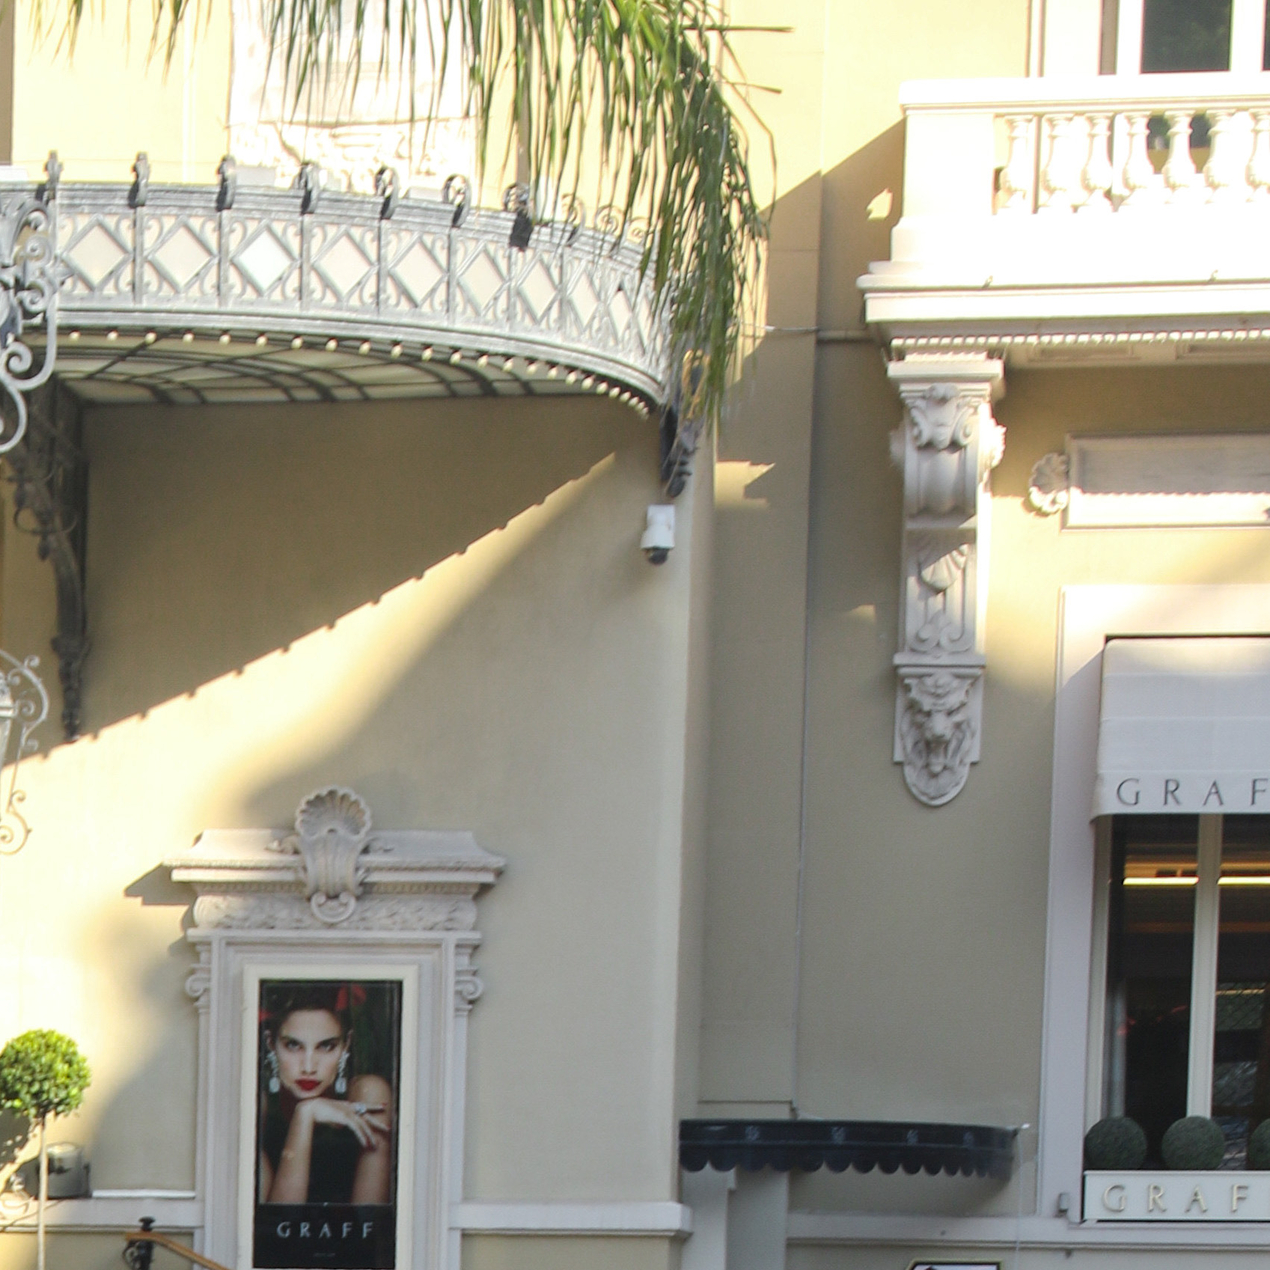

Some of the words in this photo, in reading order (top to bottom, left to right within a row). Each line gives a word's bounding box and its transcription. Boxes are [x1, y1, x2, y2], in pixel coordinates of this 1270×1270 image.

[1116, 777, 1269, 806] GRAF
[1103, 1183, 1249, 1213] GRAF
[276, 1221, 374, 1239] GRAFF
